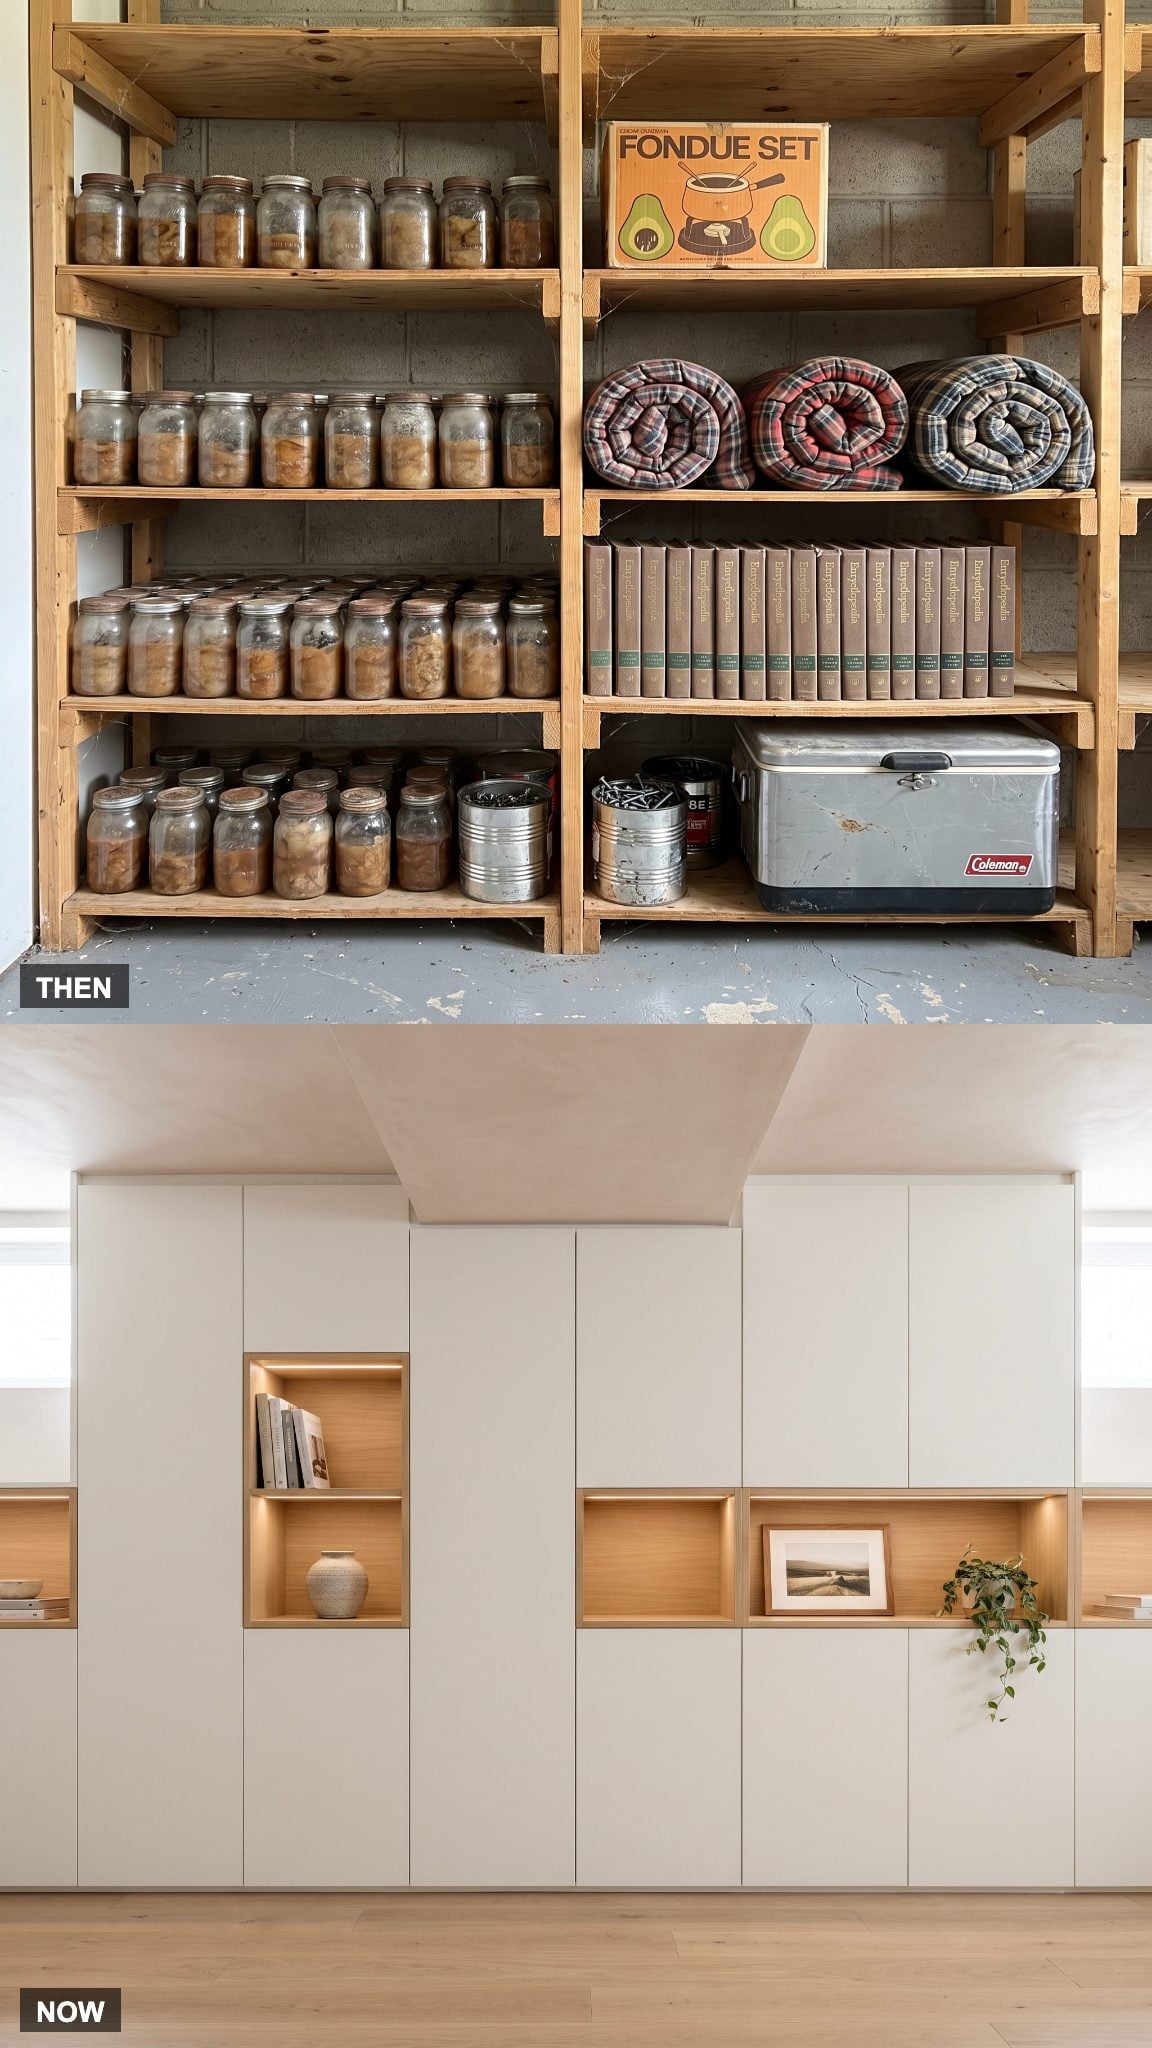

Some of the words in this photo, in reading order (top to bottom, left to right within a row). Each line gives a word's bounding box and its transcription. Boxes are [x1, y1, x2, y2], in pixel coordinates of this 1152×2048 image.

[619, 135, 750, 159] FONDUE
[758, 135, 818, 160] SET
[971, 857, 1019, 871] Coleman
